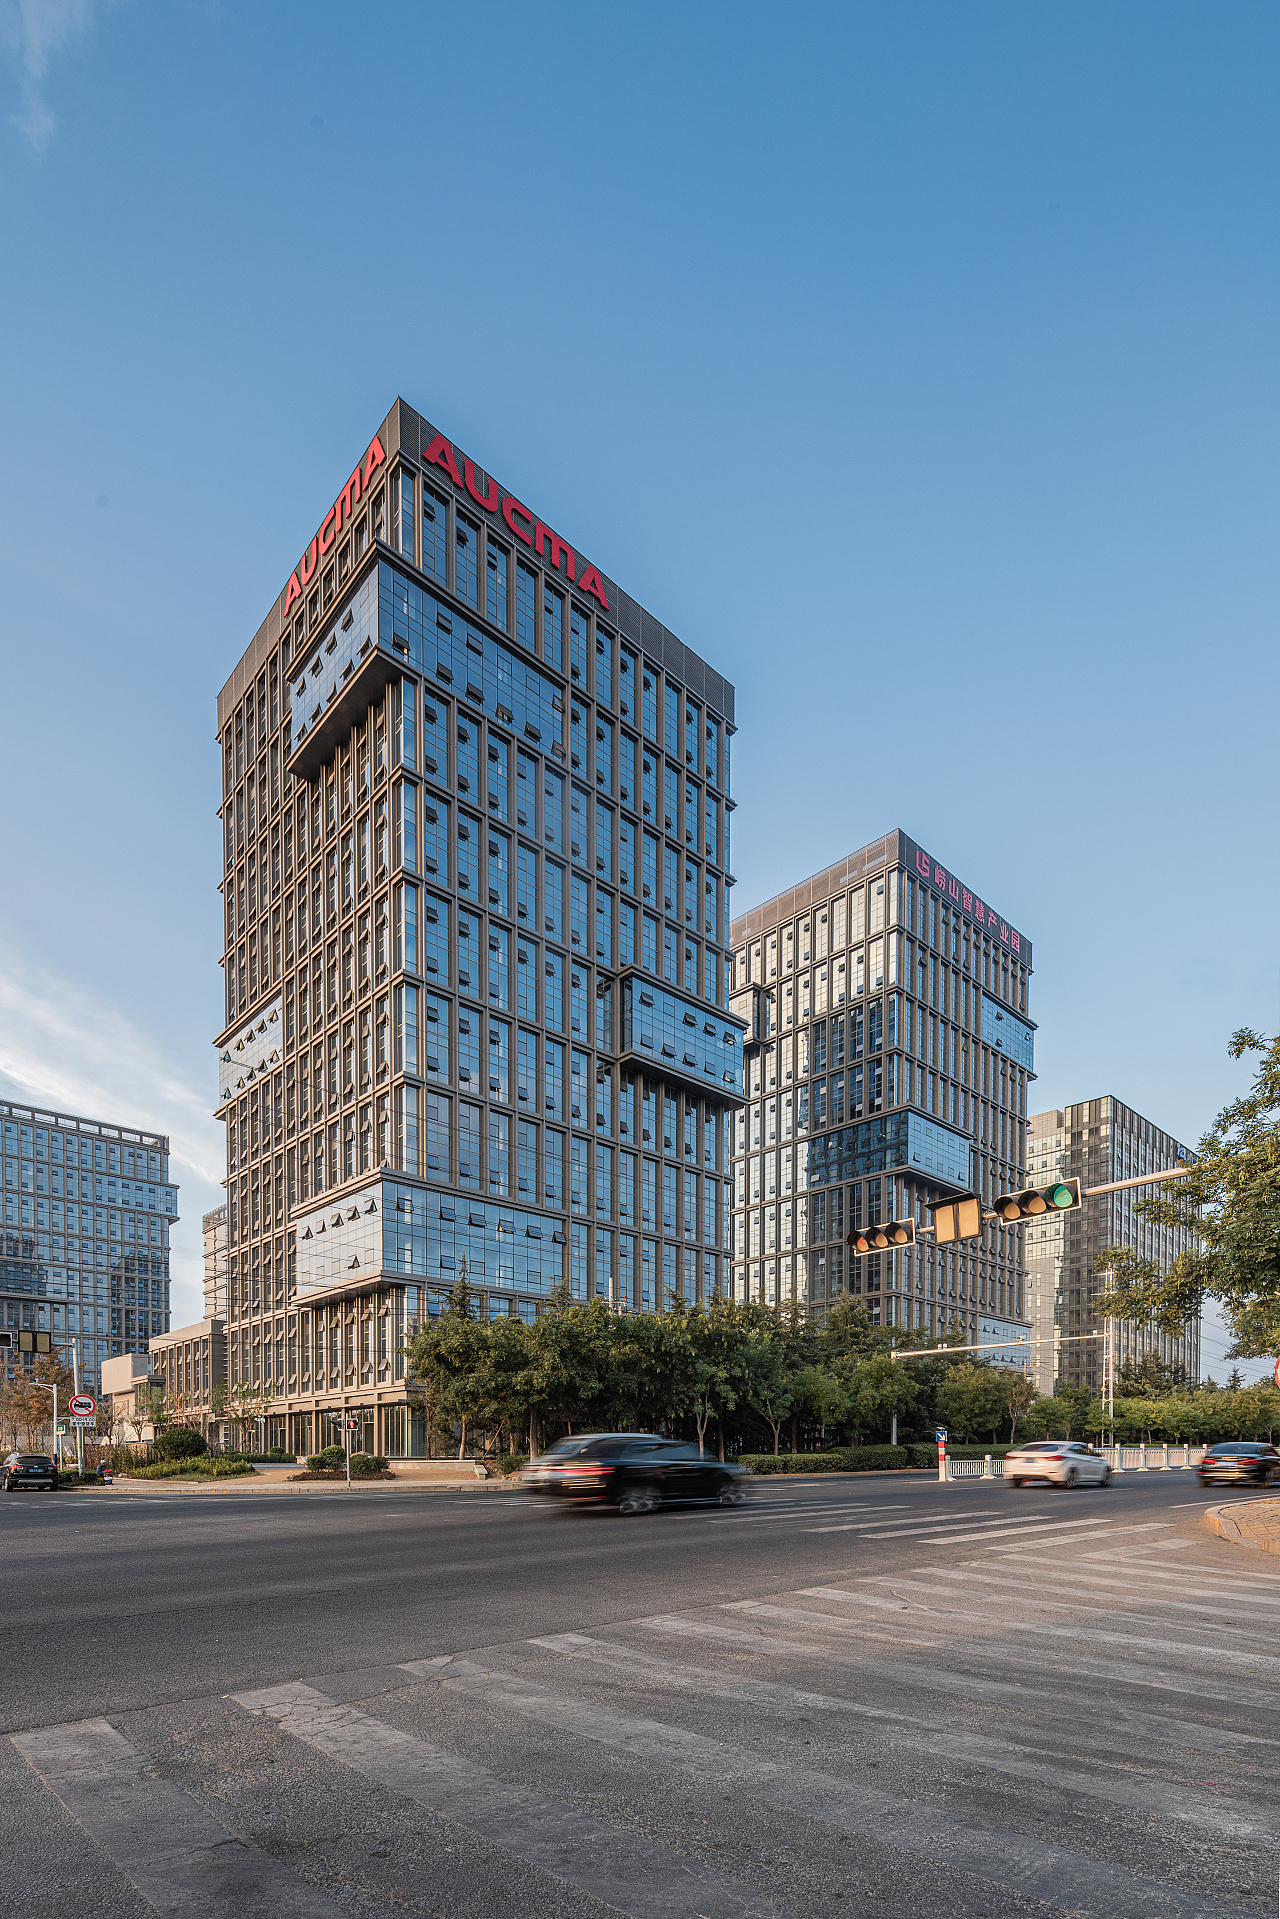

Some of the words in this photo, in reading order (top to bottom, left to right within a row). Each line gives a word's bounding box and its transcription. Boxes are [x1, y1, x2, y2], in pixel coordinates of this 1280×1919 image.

[284, 435, 386, 618] AUCMA
[423, 434, 611, 611] AUCMA
[935, 866, 1020, 954] 崂山智慧产业园
